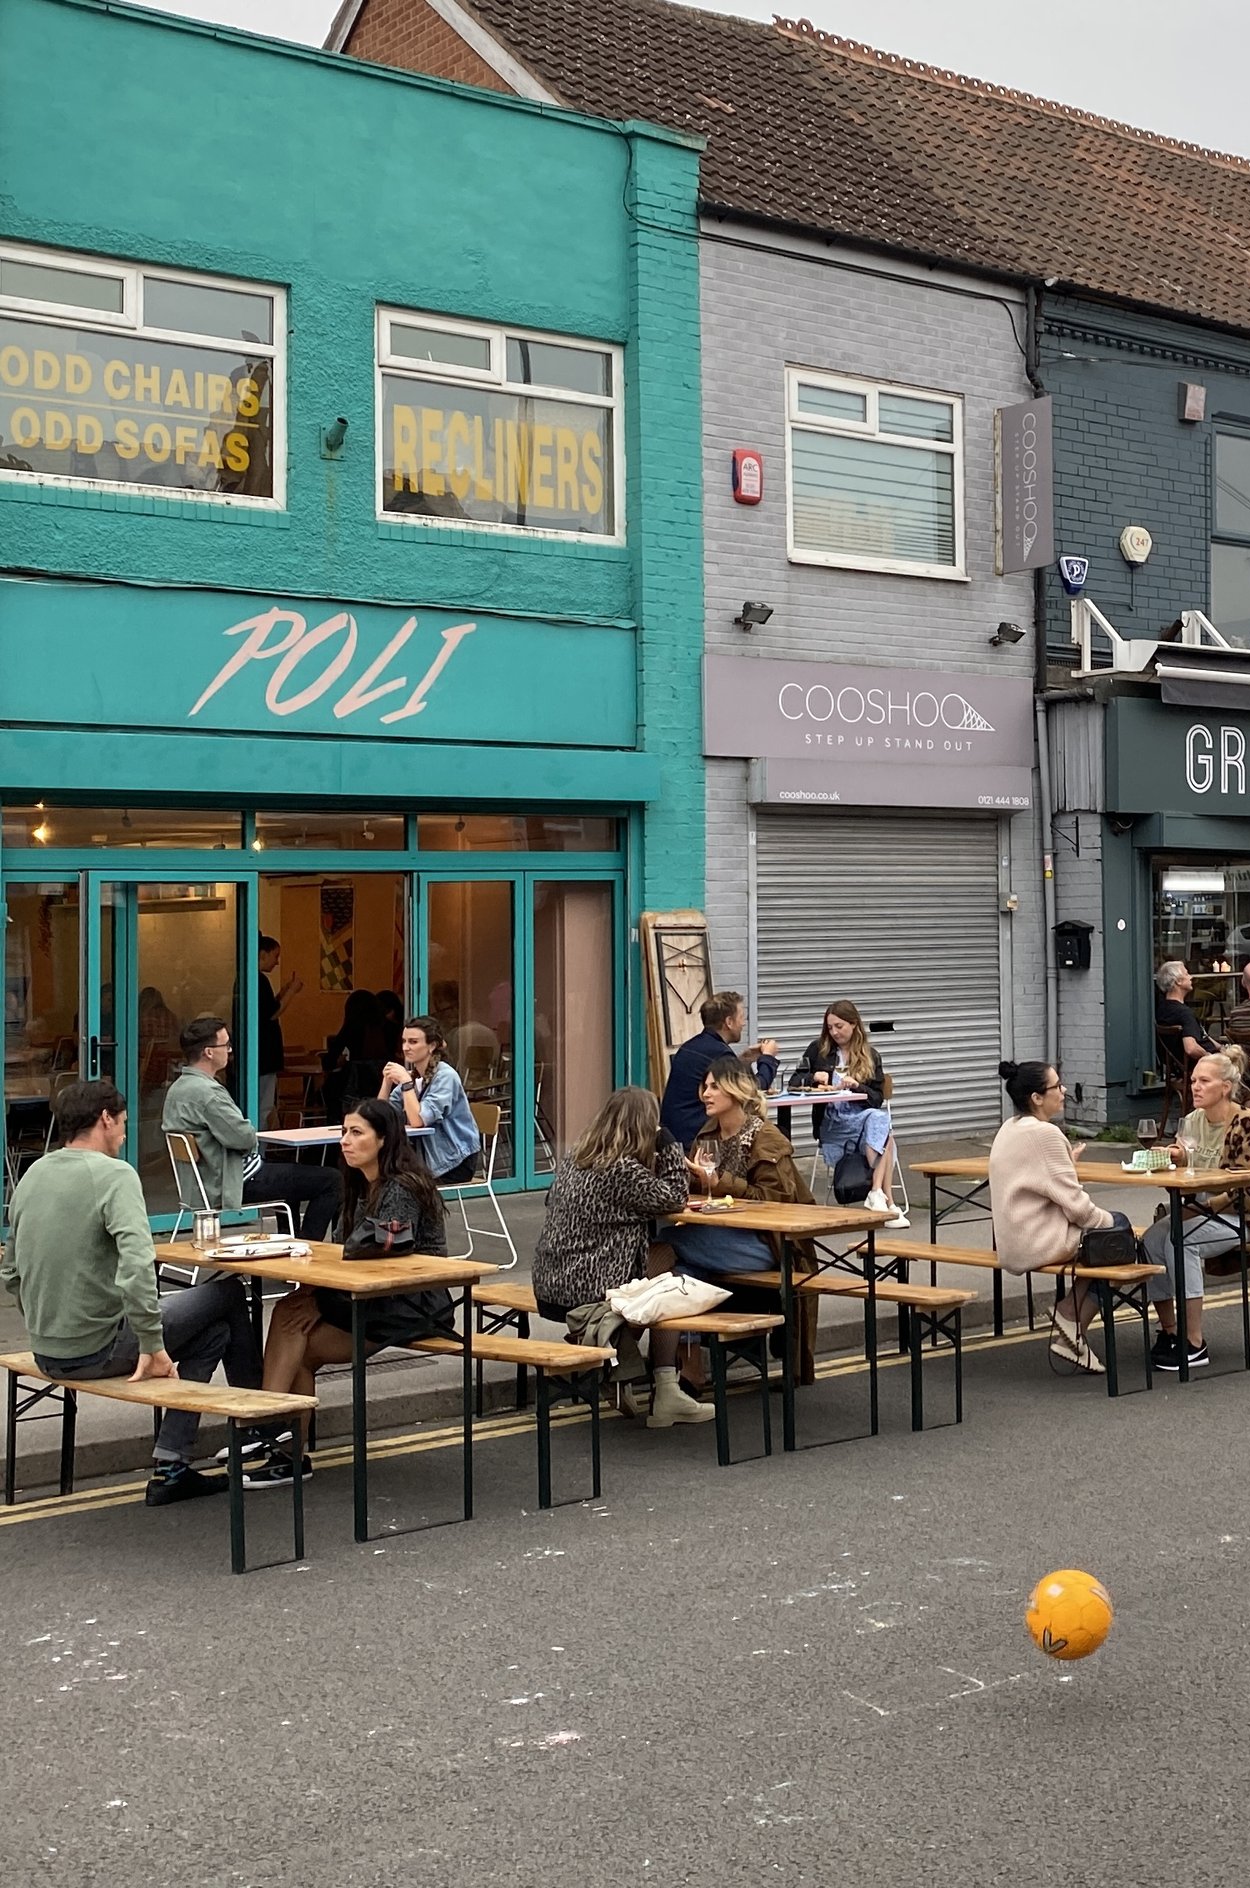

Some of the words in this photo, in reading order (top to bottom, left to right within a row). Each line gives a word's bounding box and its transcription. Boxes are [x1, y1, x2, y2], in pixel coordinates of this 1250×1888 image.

[0, 345, 92, 394] ODD
[103, 359, 261, 417] CHAIRS
[10, 406, 103, 454] ODD
[114, 419, 250, 472] SOFAS
[393, 403, 604, 514] RECLINERS
[1022, 412, 1037, 540] COOSHOO
[187, 606, 477, 724] POLI
[779, 683, 967, 730] COOSHOO
[805, 734, 845, 745] STEP
[855, 736, 874, 746] UP
[884, 737, 934, 750] STAND
[944, 741, 972, 751] OUT
[779, 790, 840, 801] cooshoo.co.uk
[995, 796, 1010, 805] 444
